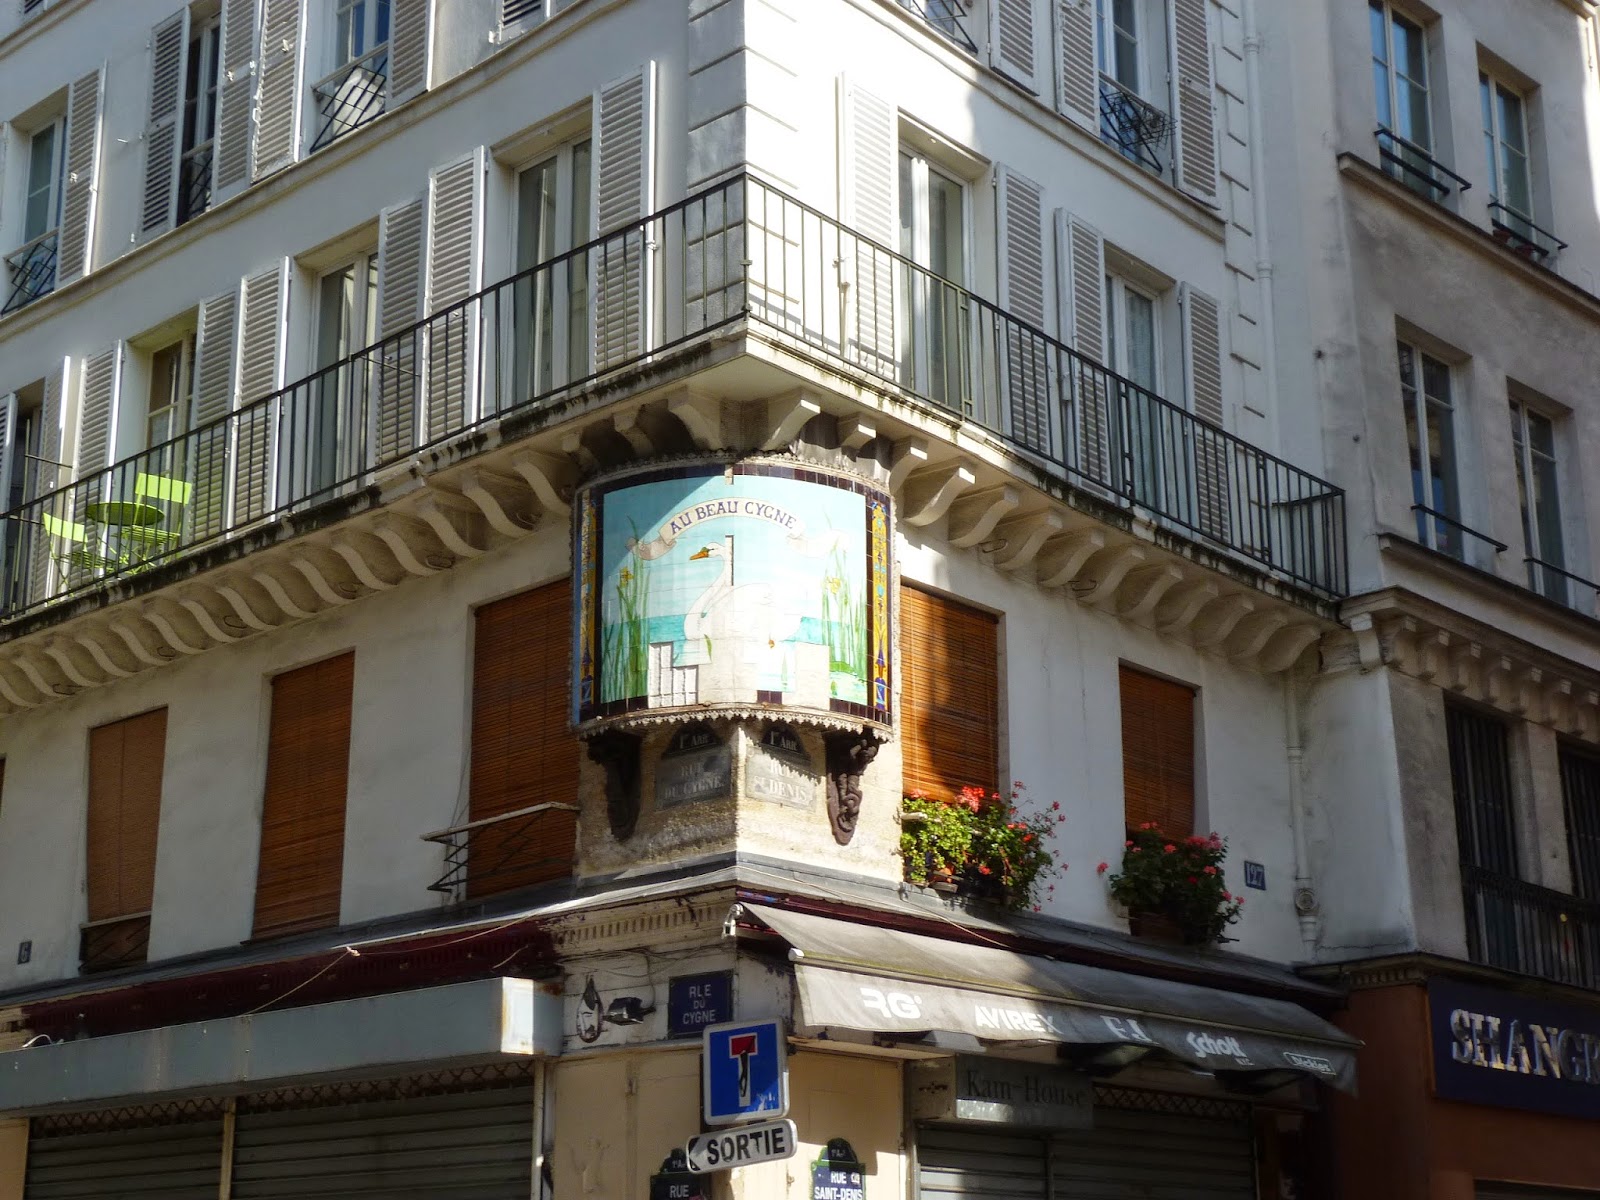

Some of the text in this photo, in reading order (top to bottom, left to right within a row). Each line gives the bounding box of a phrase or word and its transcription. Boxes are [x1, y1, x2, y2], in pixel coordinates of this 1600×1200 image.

[670, 500, 797, 535] AU BEAU CYGNE
[1246, 862, 1263, 886] 127
[693, 997, 706, 1009] DU
[682, 1009, 716, 1025] CYGNE
[974, 1004, 1064, 1035] AVIREX
[1186, 1031, 1247, 1058] Schott
[707, 1127, 786, 1164] SORTIE
[830, 1171, 847, 1185] RUE
[669, 1184, 690, 1199] RUE
[814, 1186, 863, 1200] SAINT-DENIS
